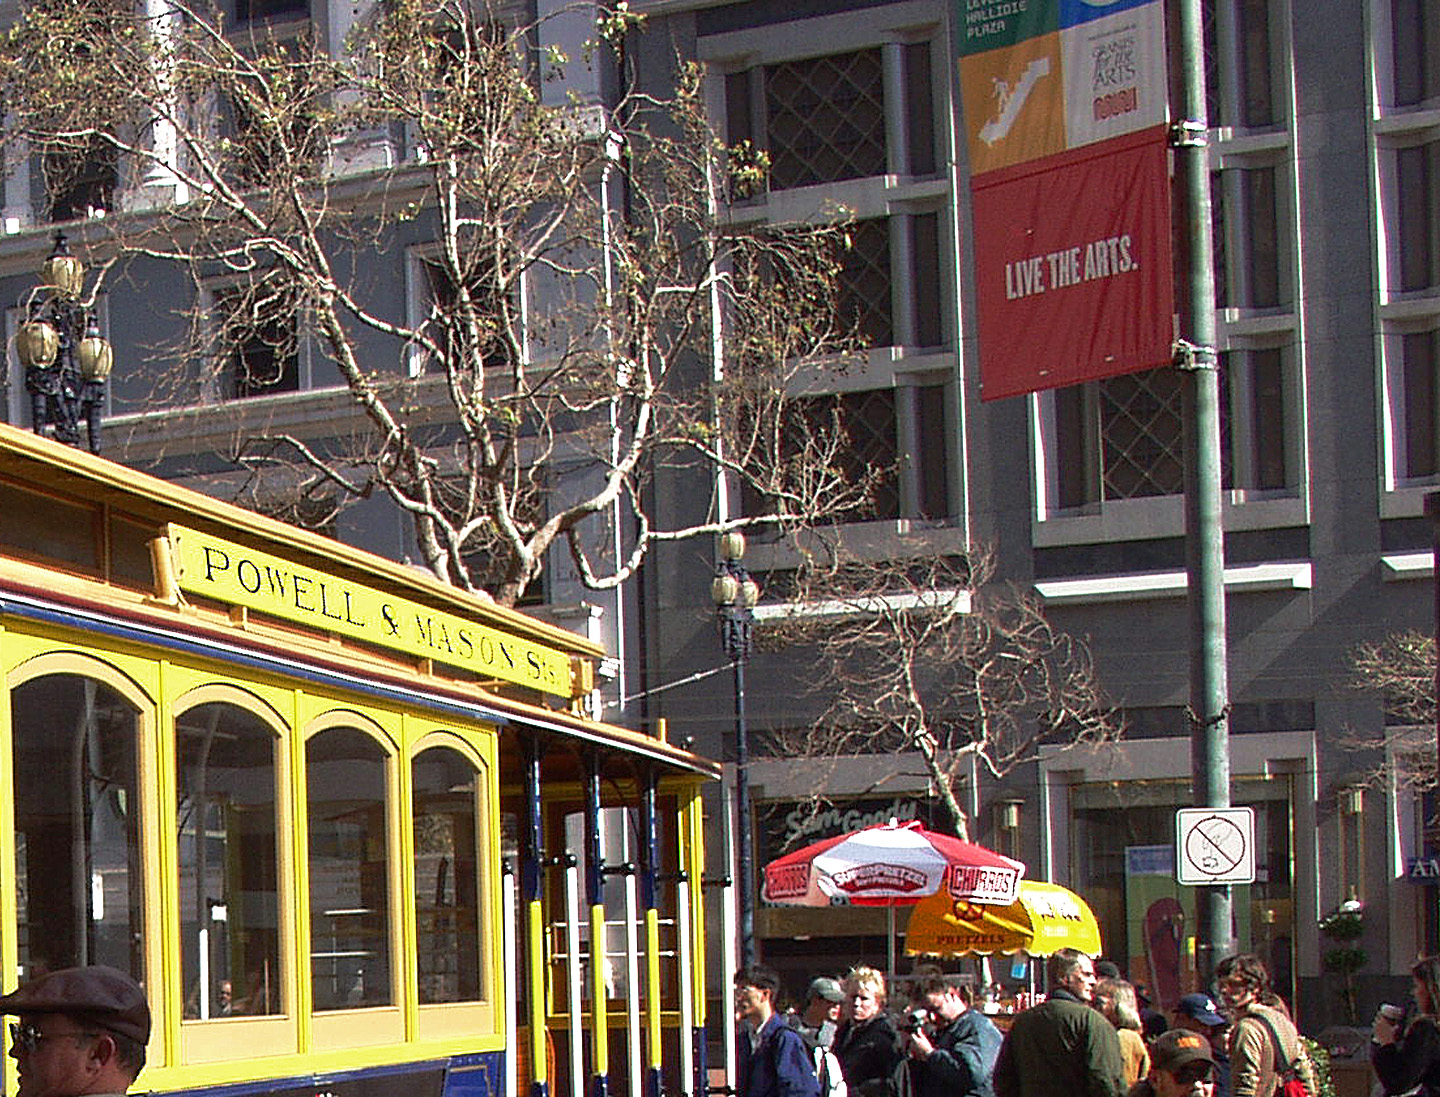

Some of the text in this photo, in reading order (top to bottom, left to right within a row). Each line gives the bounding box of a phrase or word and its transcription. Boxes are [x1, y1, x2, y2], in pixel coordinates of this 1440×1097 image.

[964, 0, 1027, 24] HALLIDIE
[966, 19, 1006, 41] PLAZA
[1005, 234, 1139, 300] LIVE THE ARTS.
[202, 546, 365, 627] POWELL
[380, 603, 402, 640] &
[415, 613, 516, 669] MASON
[952, 867, 1013, 893] CHURROS
[936, 933, 1005, 945] PRETZELS
